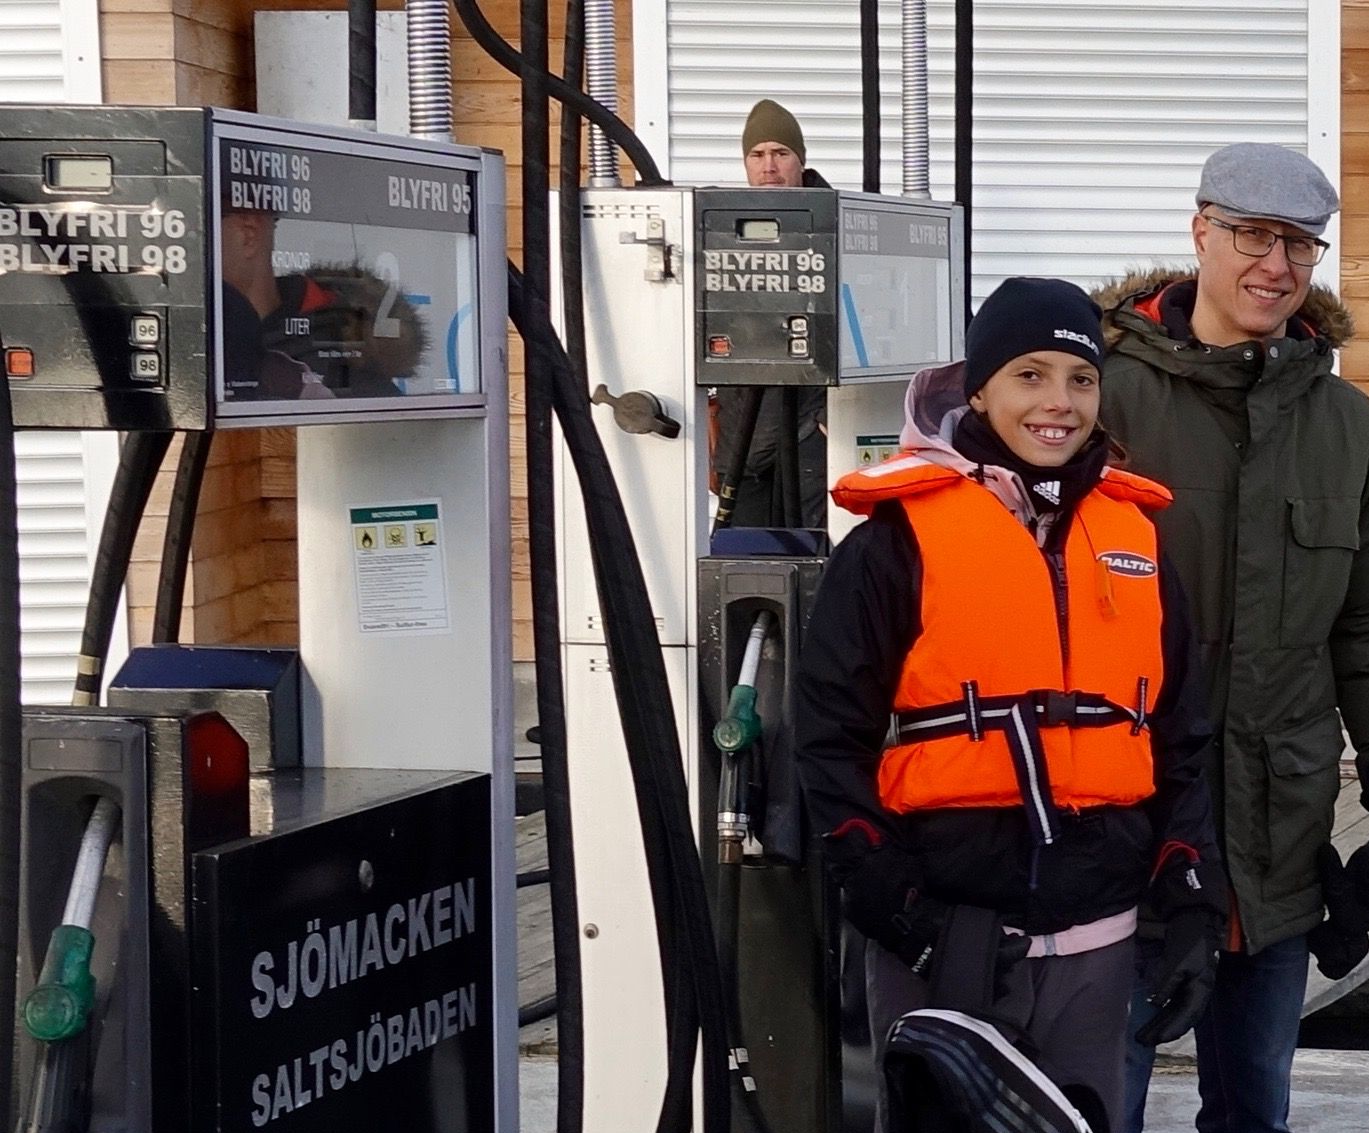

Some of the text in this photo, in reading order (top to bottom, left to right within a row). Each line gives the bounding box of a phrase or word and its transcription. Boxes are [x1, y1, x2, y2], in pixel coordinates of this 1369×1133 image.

[230, 147, 311, 182] BLYFRI 96
[231, 181, 311, 214] BLYFRI 98
[388, 176, 471, 214] BLYFRI 95
[0, 208, 186, 239] BLYFRI 96
[0, 244, 188, 274] BLYFRI 98
[705, 252, 826, 272] BLYFRI 96
[705, 273, 826, 293] BLYFRI 98
[138, 324, 156, 337] 96
[284, 317, 311, 336] LITER
[139, 359, 157, 371] 98
[250, 876, 476, 1020] SJÖMACKEN
[251, 981, 477, 1128] SALTSJÖBADEN
